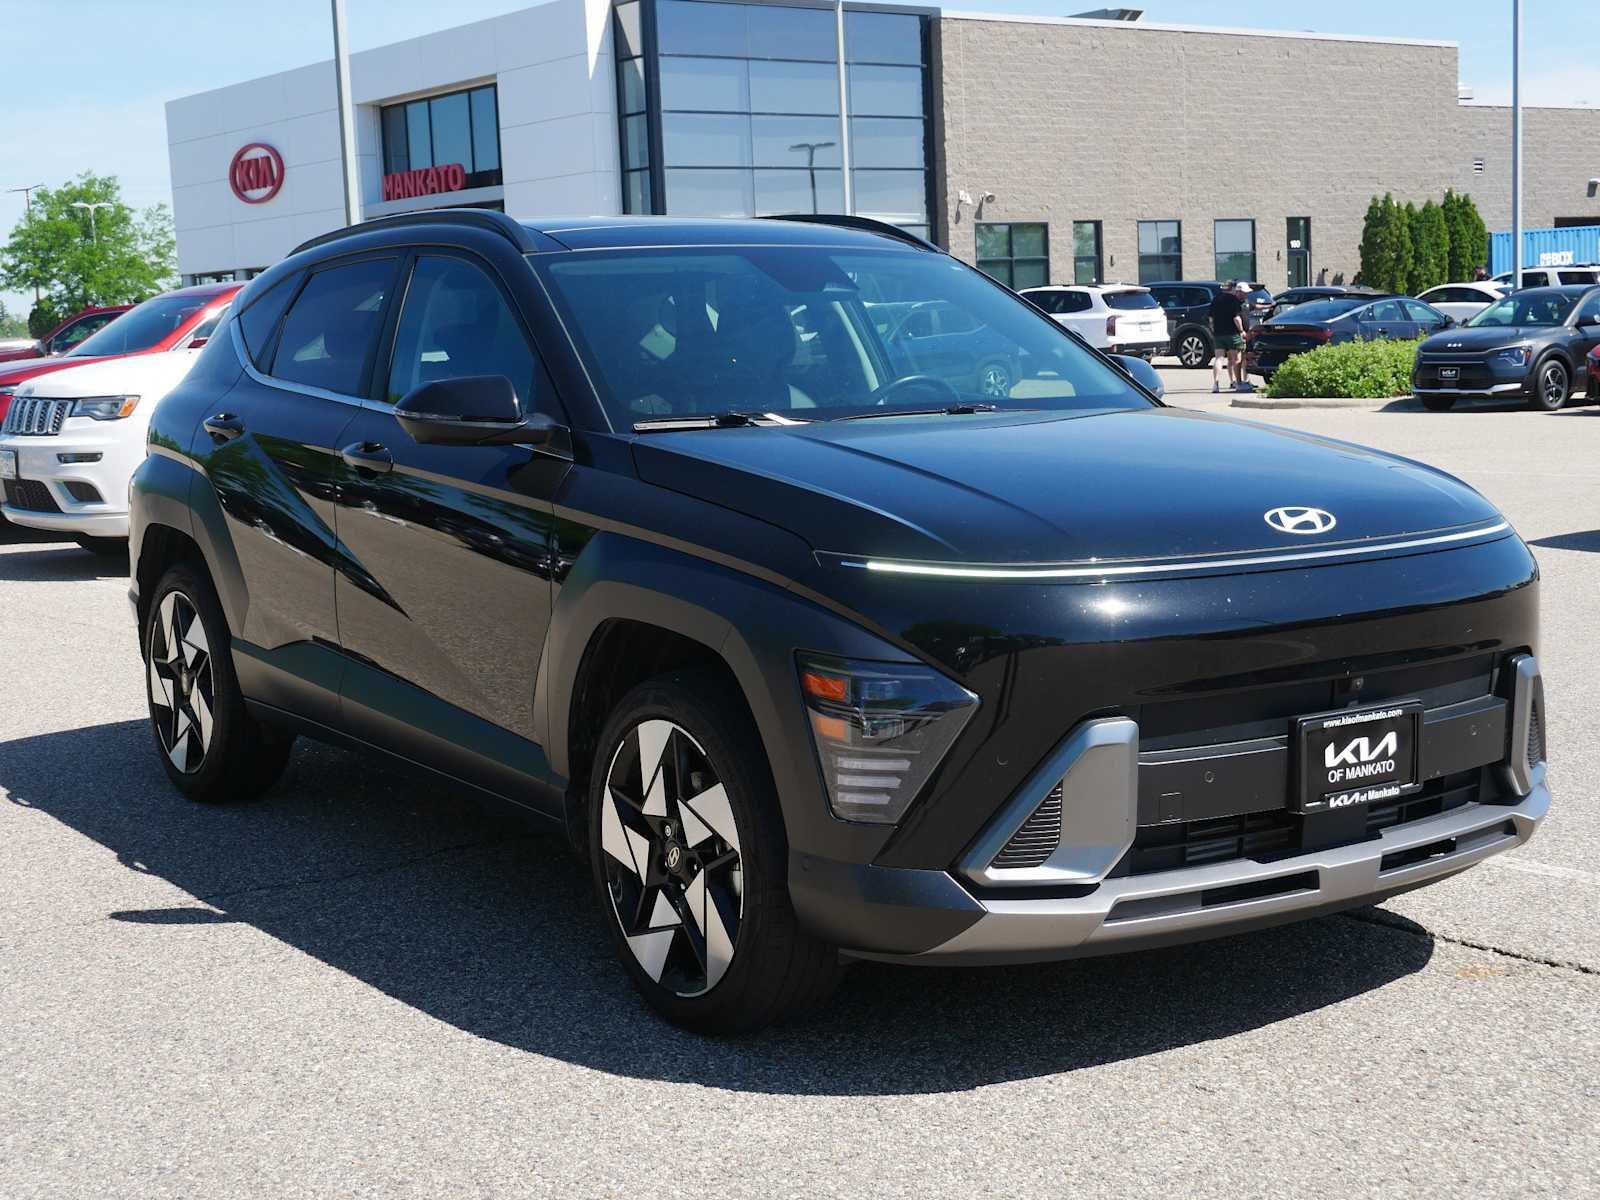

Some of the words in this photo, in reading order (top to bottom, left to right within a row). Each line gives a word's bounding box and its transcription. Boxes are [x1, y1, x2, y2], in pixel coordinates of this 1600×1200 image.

[236, 155, 276, 192] KIA
[383, 163, 465, 201] MANKATO
[1323, 709, 1403, 728] www.kiaofmankato.com
[1325, 731, 1397, 768] KIA
[1328, 769, 1344, 783] OF
[1345, 759, 1395, 780] MANKATO
[1329, 792, 1360, 808] KIA
[1360, 794, 1367, 802] of
[1368, 786, 1400, 800] Mankato
